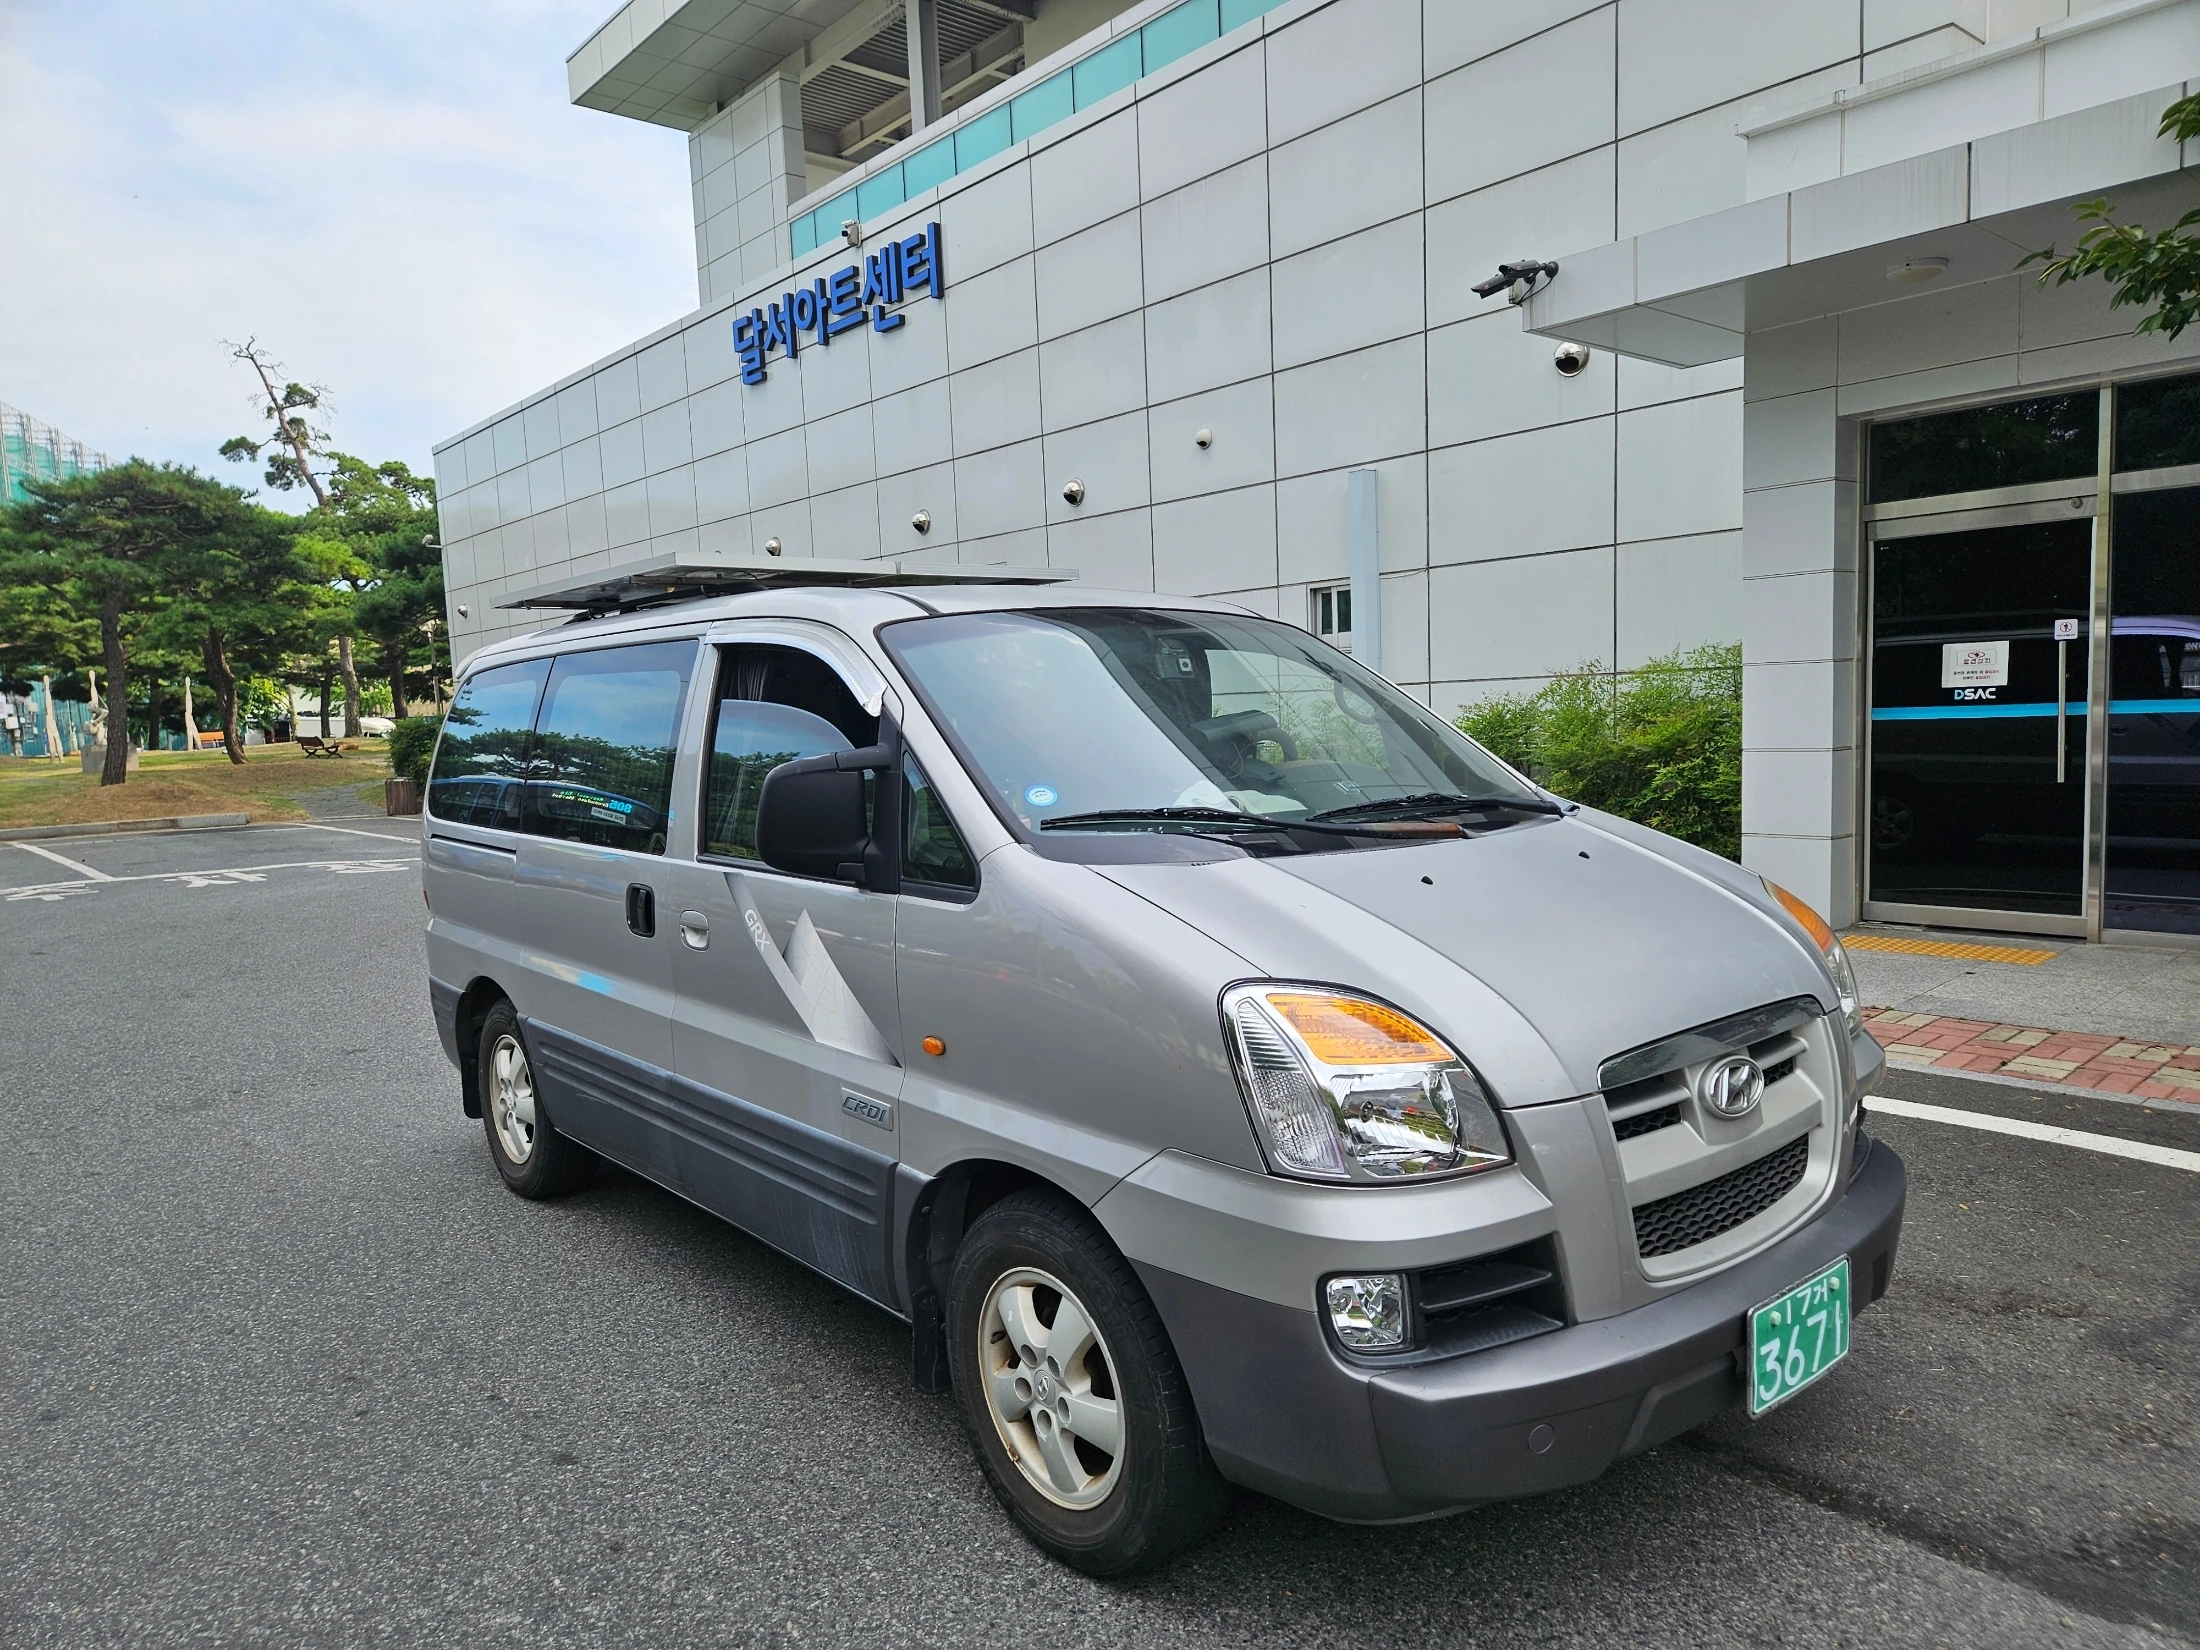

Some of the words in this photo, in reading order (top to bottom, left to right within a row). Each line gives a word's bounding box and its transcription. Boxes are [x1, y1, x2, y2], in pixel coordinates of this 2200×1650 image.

[733, 222, 943, 385] 달서아트센터
[1954, 687, 1996, 700] DSAC
[744, 909, 771, 952] GRX
[842, 1096, 887, 1123] CRDI
[1759, 1300, 1841, 1402] 3671
